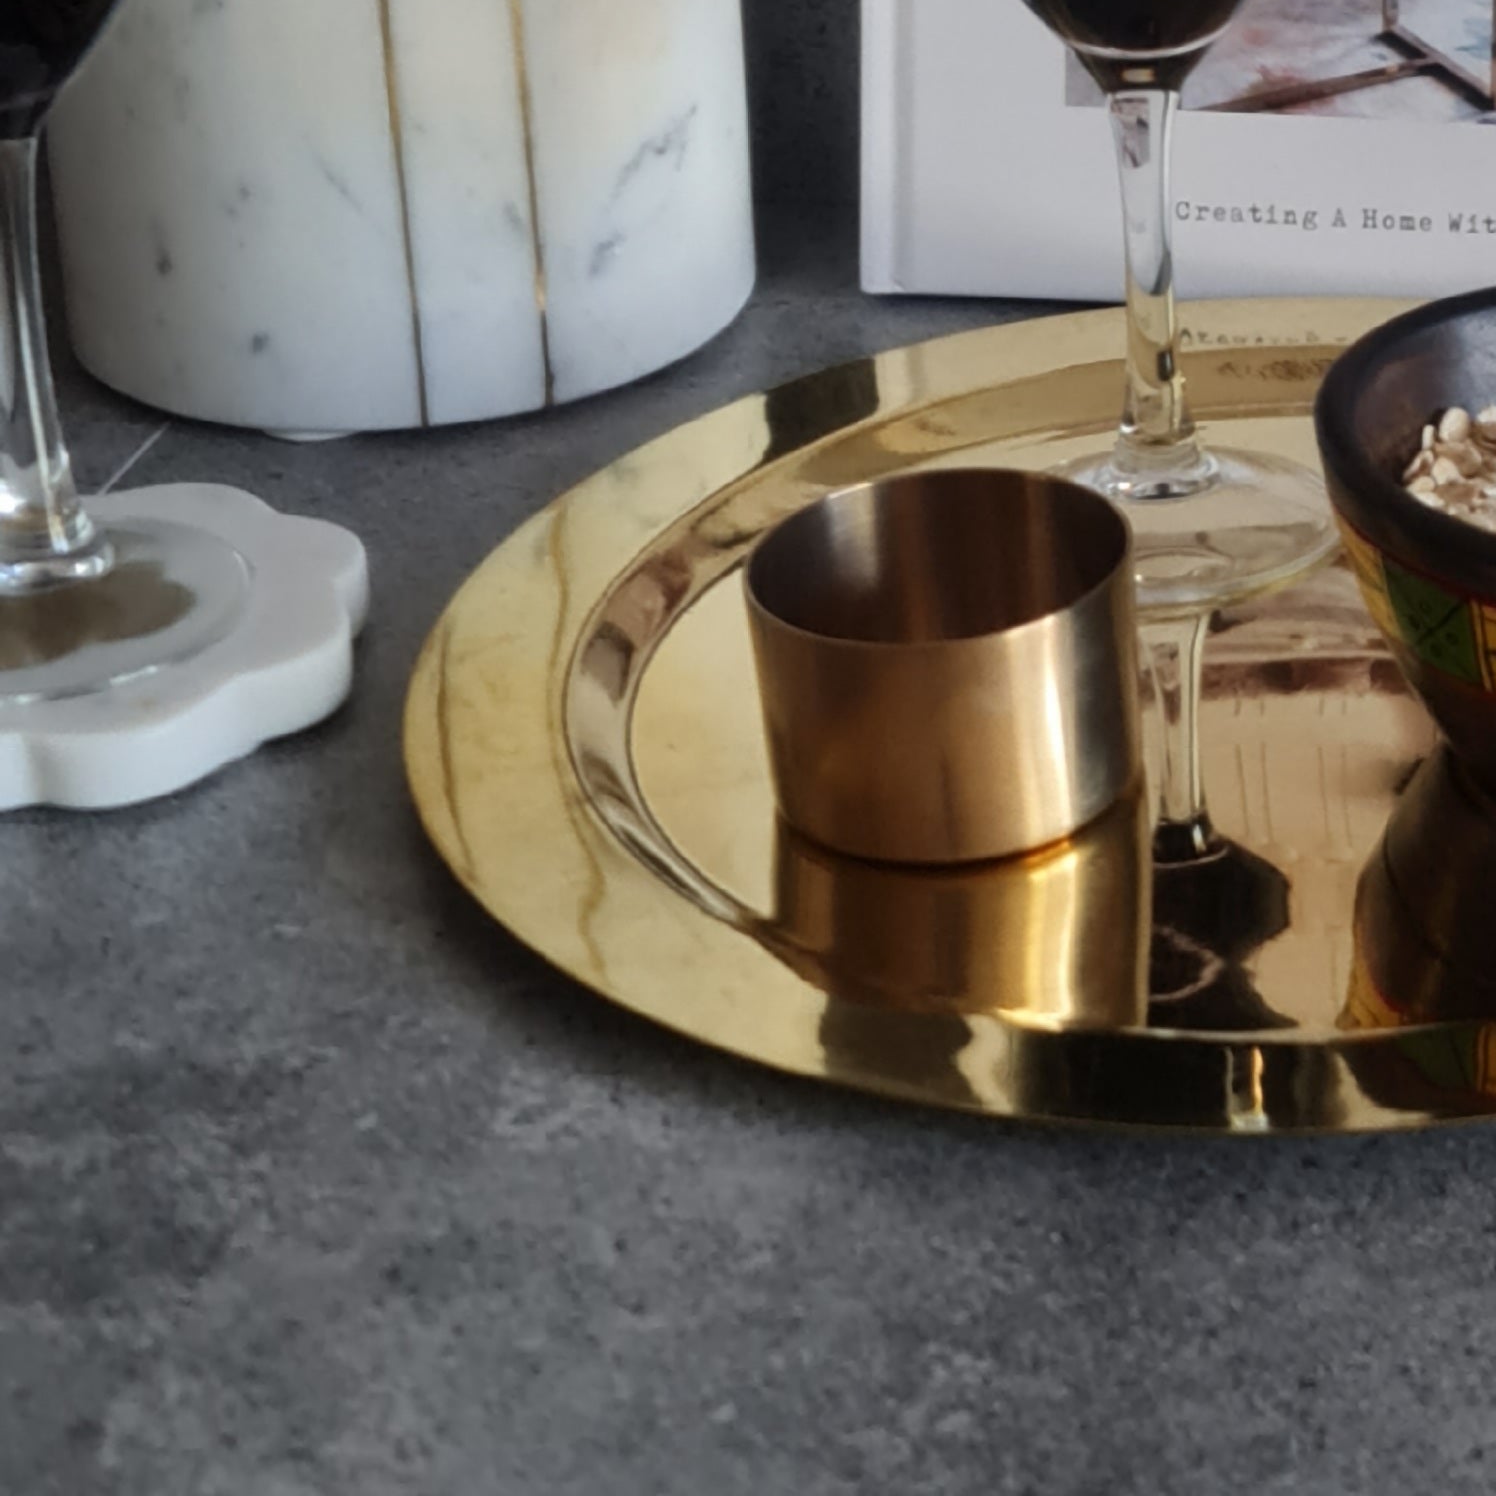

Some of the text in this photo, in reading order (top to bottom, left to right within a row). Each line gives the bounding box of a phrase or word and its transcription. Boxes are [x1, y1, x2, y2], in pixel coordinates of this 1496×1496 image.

[1175, 200, 1318, 231] Creating
[1330, 207, 1348, 228] A
[1361, 207, 1433, 232] Home
